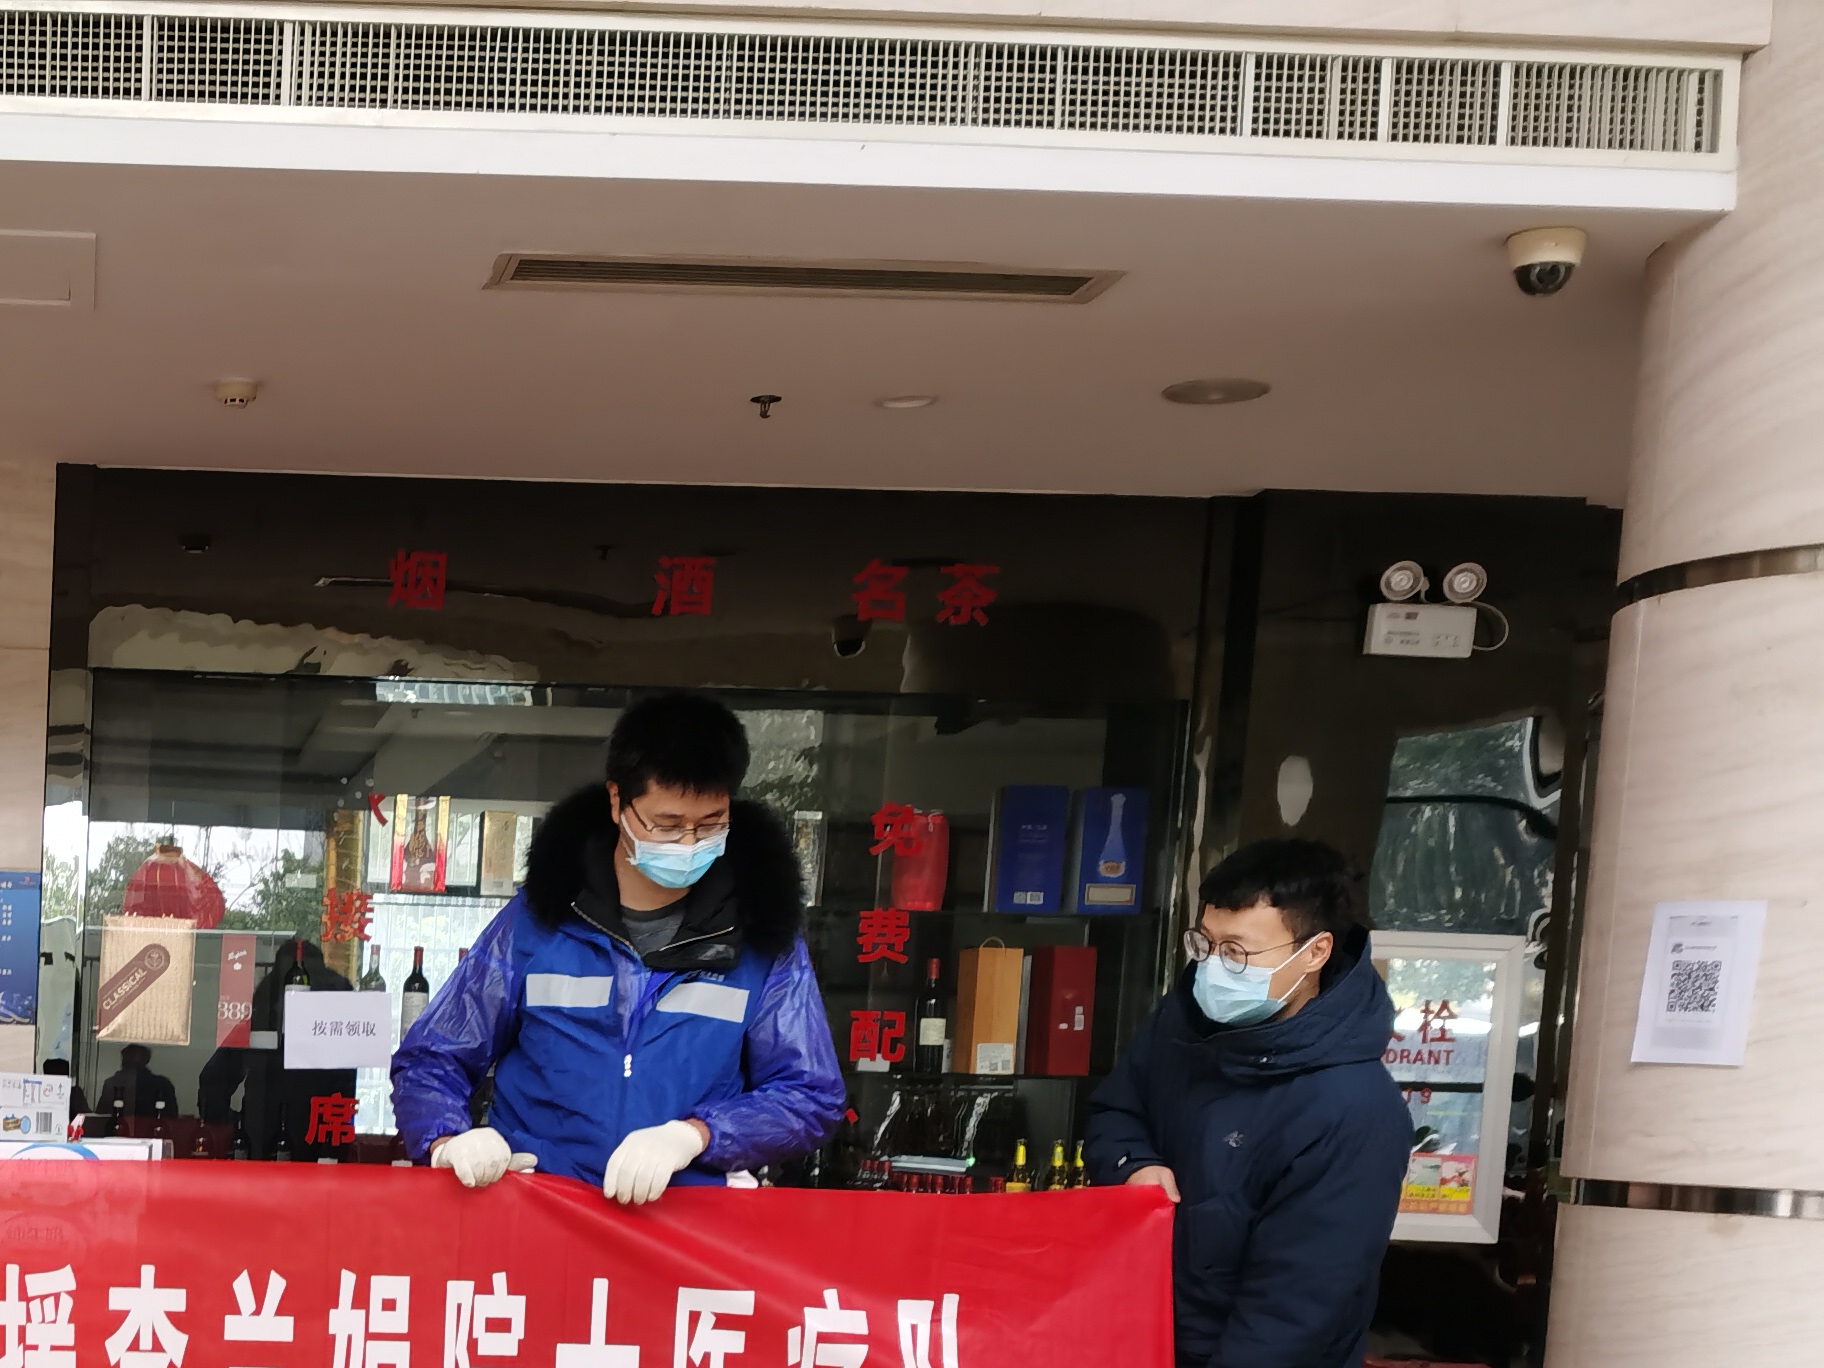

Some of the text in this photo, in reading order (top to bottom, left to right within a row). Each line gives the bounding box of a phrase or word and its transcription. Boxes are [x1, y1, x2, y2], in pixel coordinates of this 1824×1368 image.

[387, 549, 1001, 627] 烟 酒 名茶
[102, 967, 148, 1011] CLASSICAL
[311, 1020, 377, 1037] 按需领取
